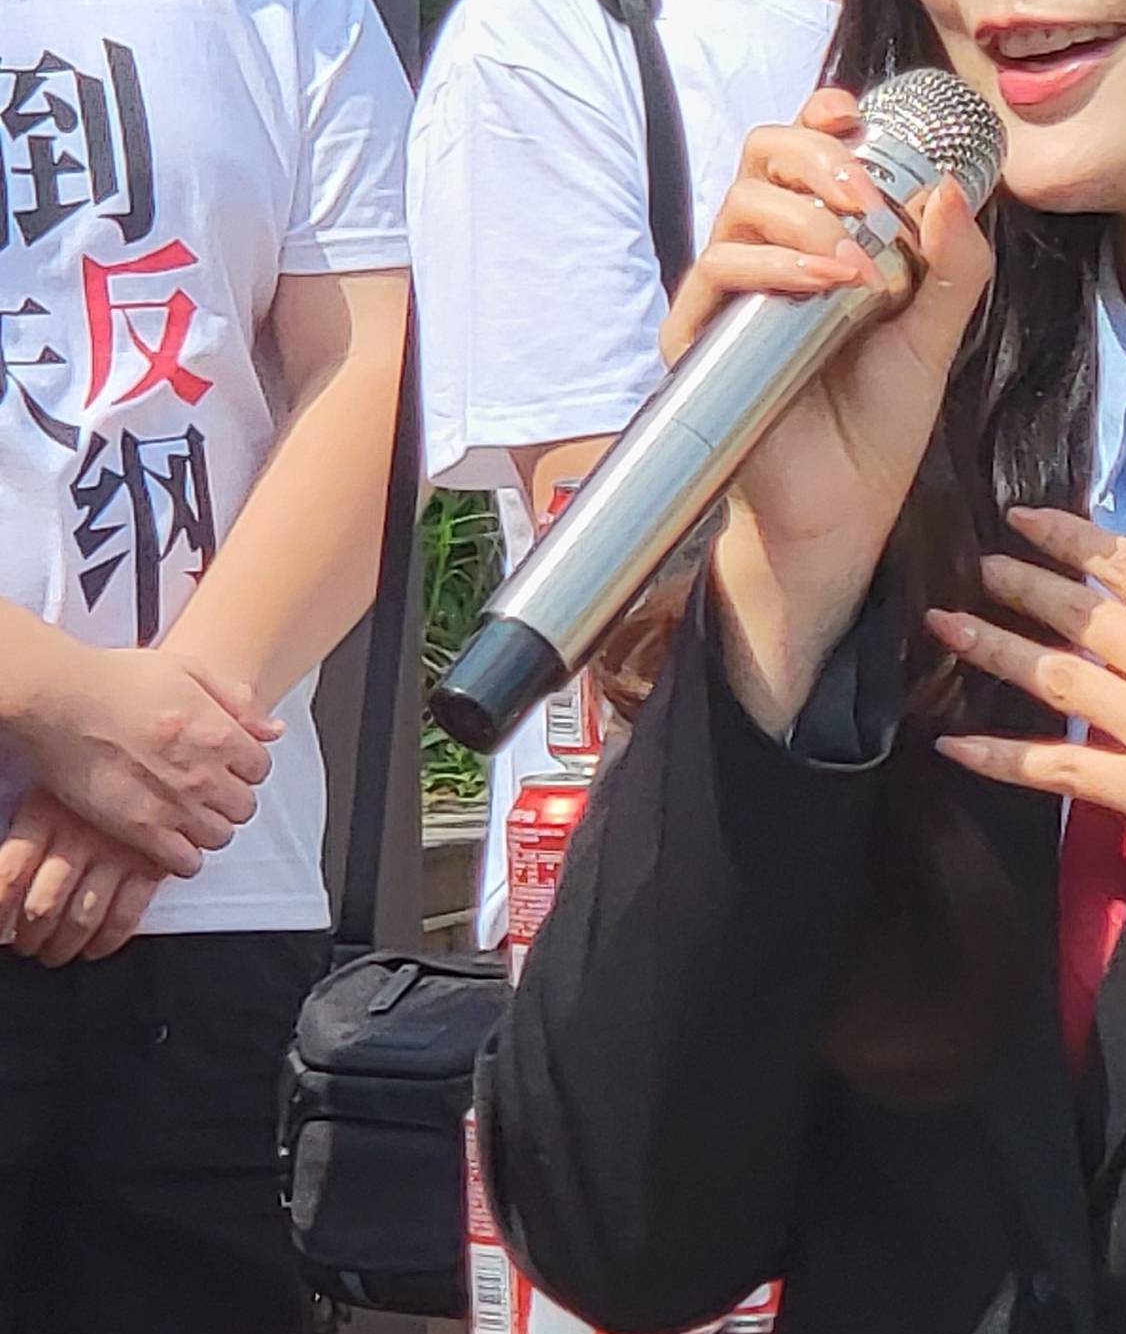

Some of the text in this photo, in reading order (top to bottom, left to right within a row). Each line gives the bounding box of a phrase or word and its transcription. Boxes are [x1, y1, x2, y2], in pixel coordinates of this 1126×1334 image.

[0, 37, 155, 248] 倒
[82, 239, 213, 411] 反
[69, 423, 216, 649] 纲
